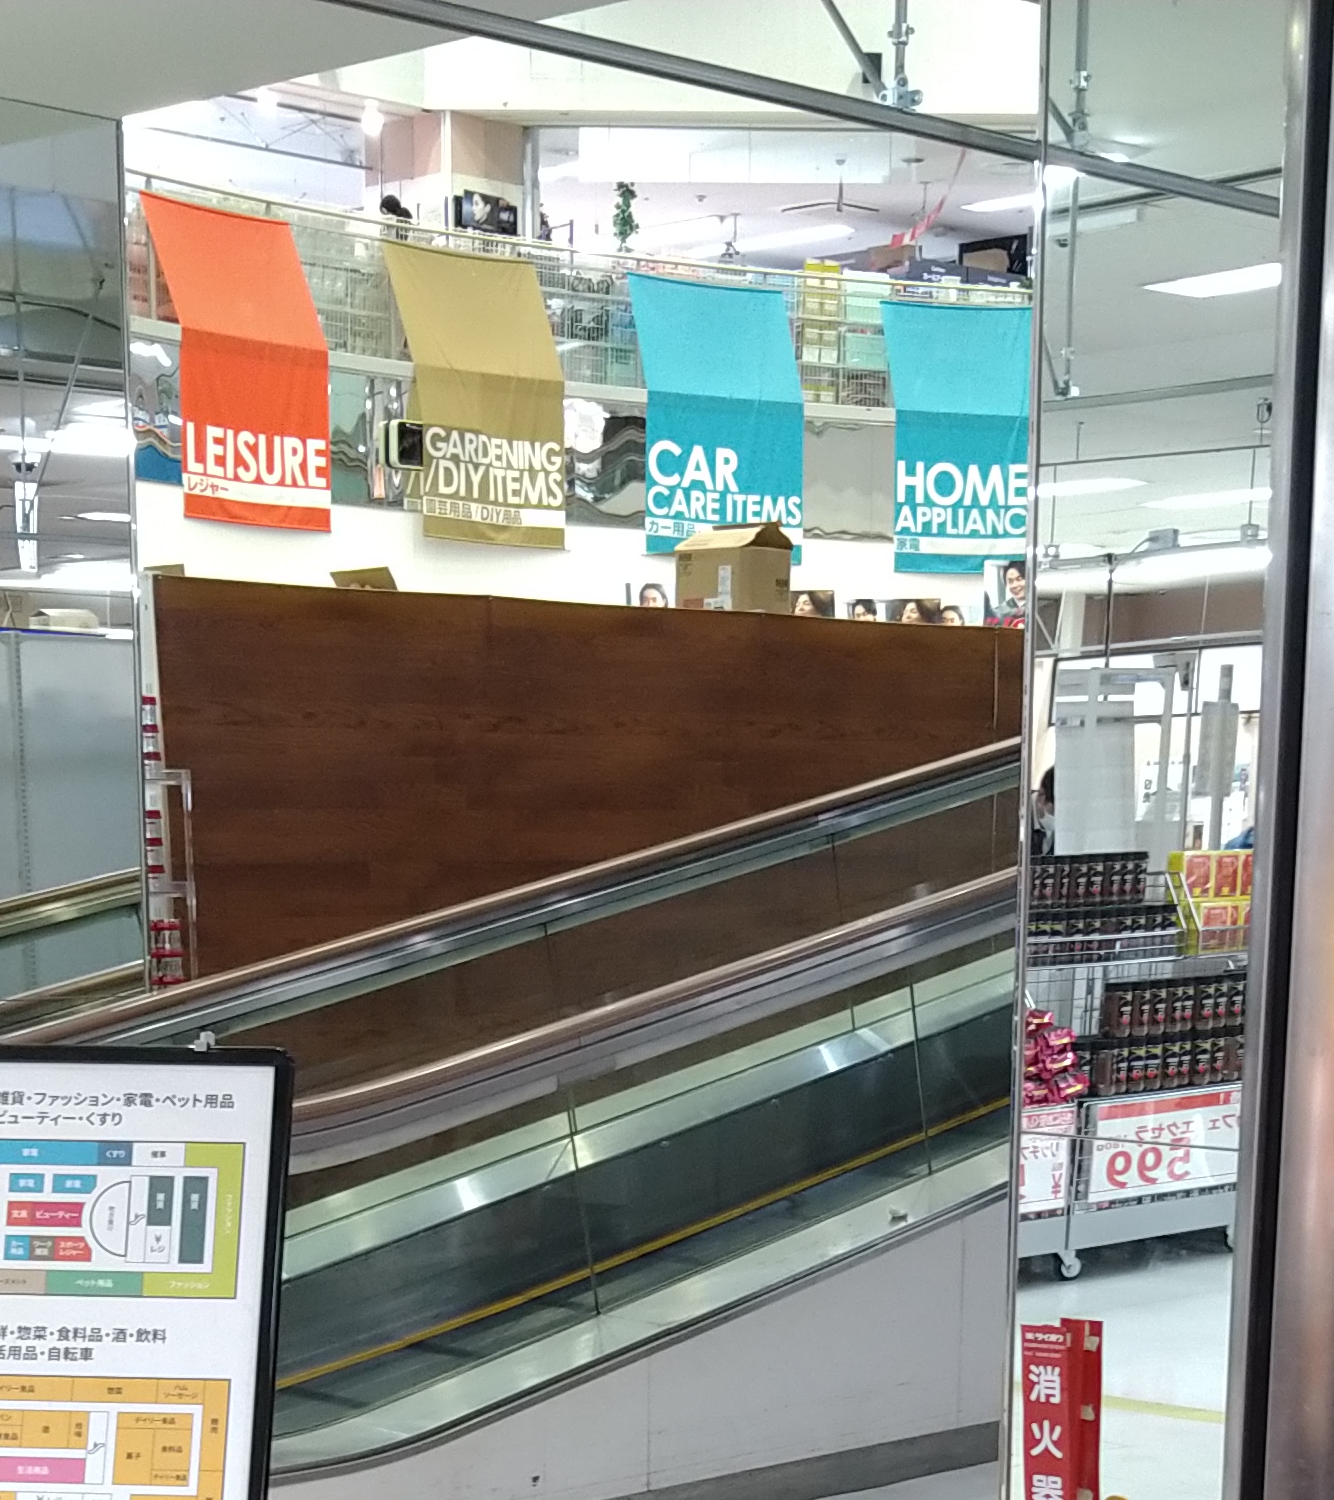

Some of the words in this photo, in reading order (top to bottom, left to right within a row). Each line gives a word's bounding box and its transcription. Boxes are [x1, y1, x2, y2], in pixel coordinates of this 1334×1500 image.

[185, 421, 327, 488] LEISURE
[425, 427, 562, 472] GARDENING
[647, 440, 740, 492] CAR
[187, 475, 229, 495] レジャー
[425, 459, 487, 499] /DIY
[488, 466, 562, 507] ITEMS
[647, 486, 720, 522] CARE
[725, 493, 802, 525] ITEMS
[897, 460, 1028, 507] HOME
